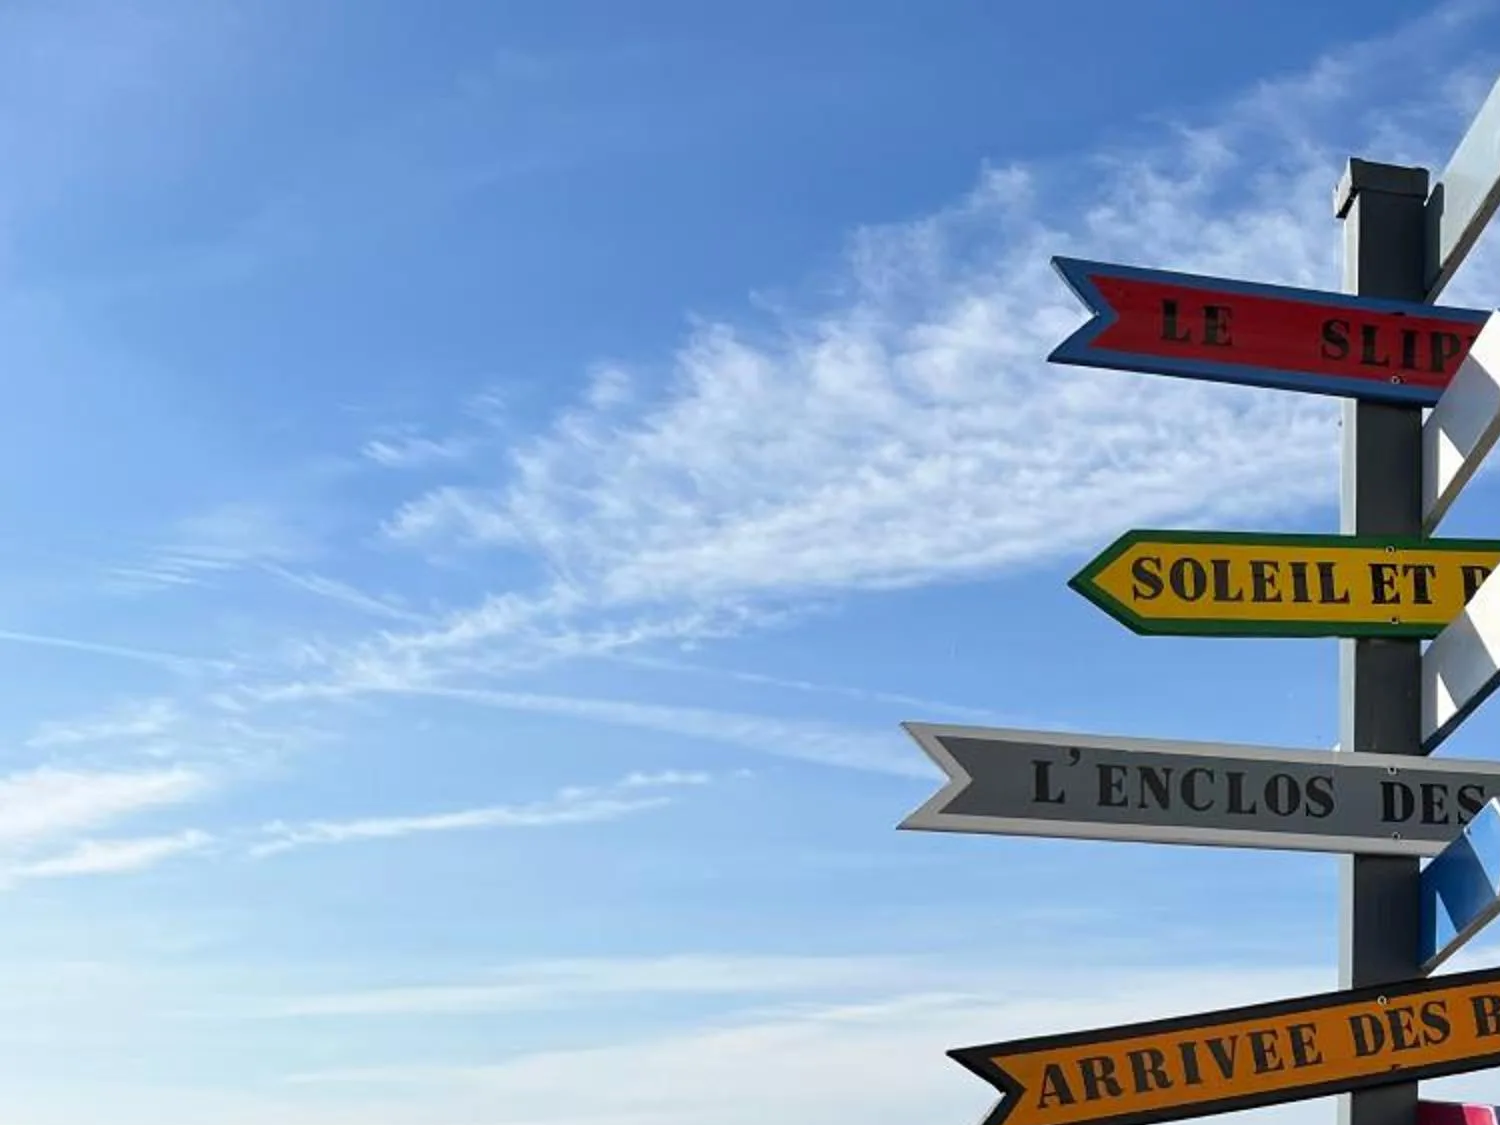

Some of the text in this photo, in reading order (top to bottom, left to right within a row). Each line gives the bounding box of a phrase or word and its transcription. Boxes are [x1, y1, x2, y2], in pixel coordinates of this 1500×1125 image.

[1161, 299, 1233, 346] LE
[1131, 557, 1350, 604] SOLEIL
[1368, 563, 1436, 605] ET
[1030, 748, 1335, 819] L'ENCLOS
[1380, 781, 1486, 824] DES
[1037, 1022, 1323, 1109] ARRIVEE
[1348, 1000, 1451, 1057] DES
